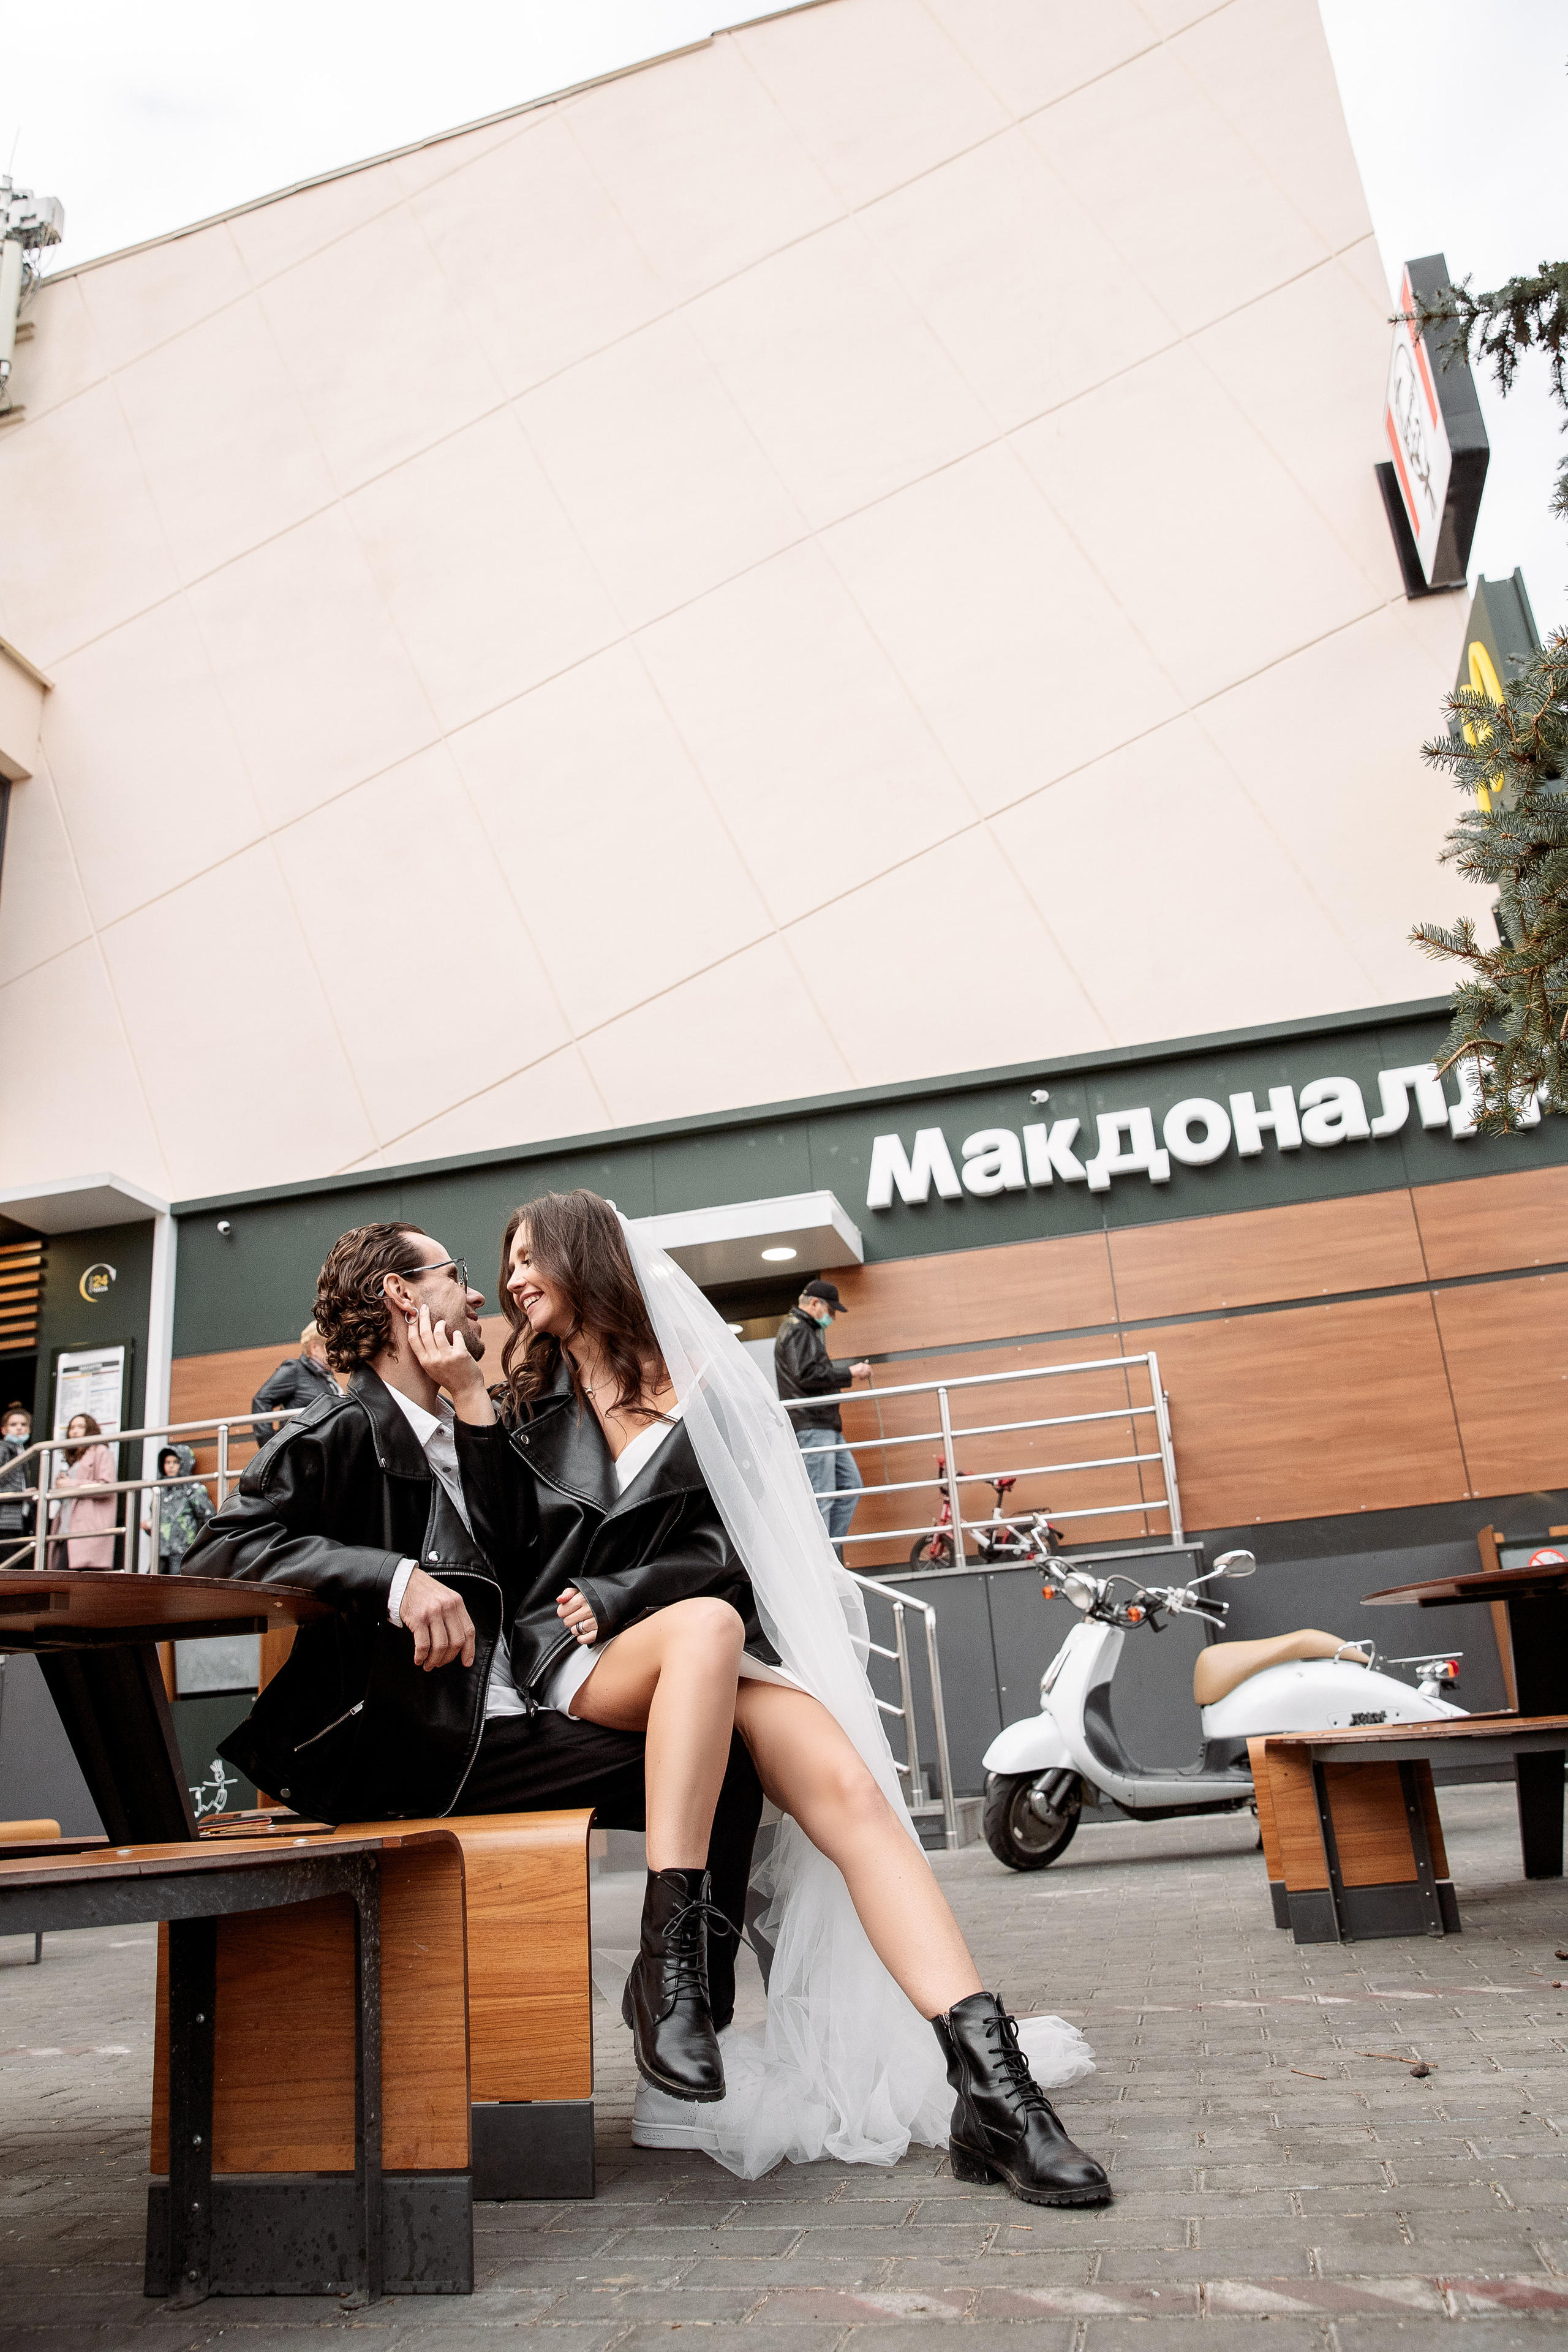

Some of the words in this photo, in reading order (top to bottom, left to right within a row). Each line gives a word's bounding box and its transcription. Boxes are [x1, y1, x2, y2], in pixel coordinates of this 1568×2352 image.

[866, 1044, 1559, 1210] Макдоналд
[92, 1274, 109, 1288] 24
[642, 2132, 665, 2141] adidas
